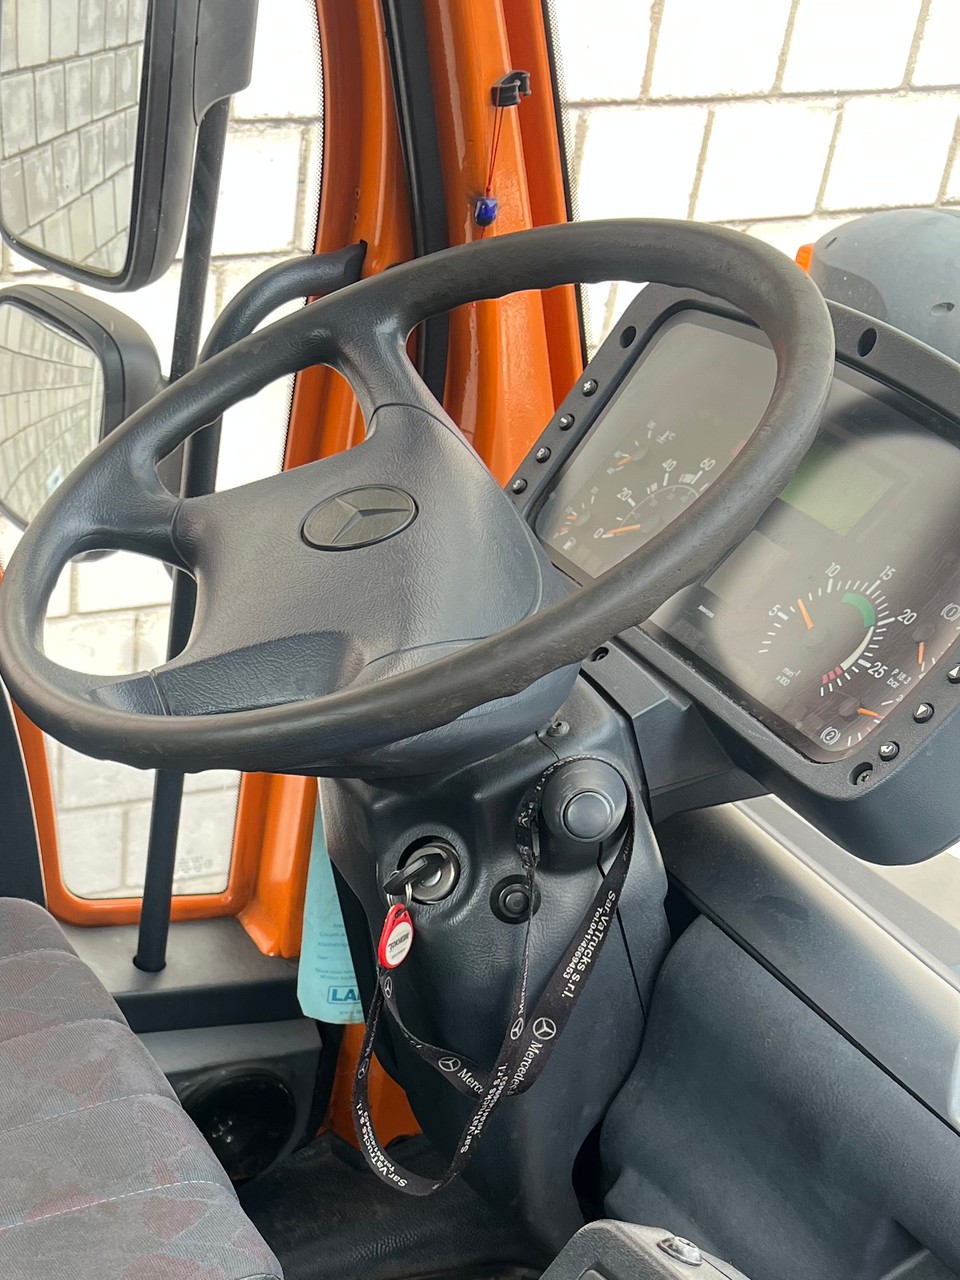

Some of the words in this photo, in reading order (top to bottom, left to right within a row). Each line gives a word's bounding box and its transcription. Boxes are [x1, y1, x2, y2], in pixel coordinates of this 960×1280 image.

[662, 458, 677, 472] 40
[700, 457, 716, 471] 60
[616, 487, 632, 501] 20
[593, 528, 604, 539] 0
[825, 562, 840, 577] 10
[879, 565, 896, 581] 15
[768, 604, 781, 616] 5
[897, 608, 917, 625] 20
[867, 661, 888, 679] 25
